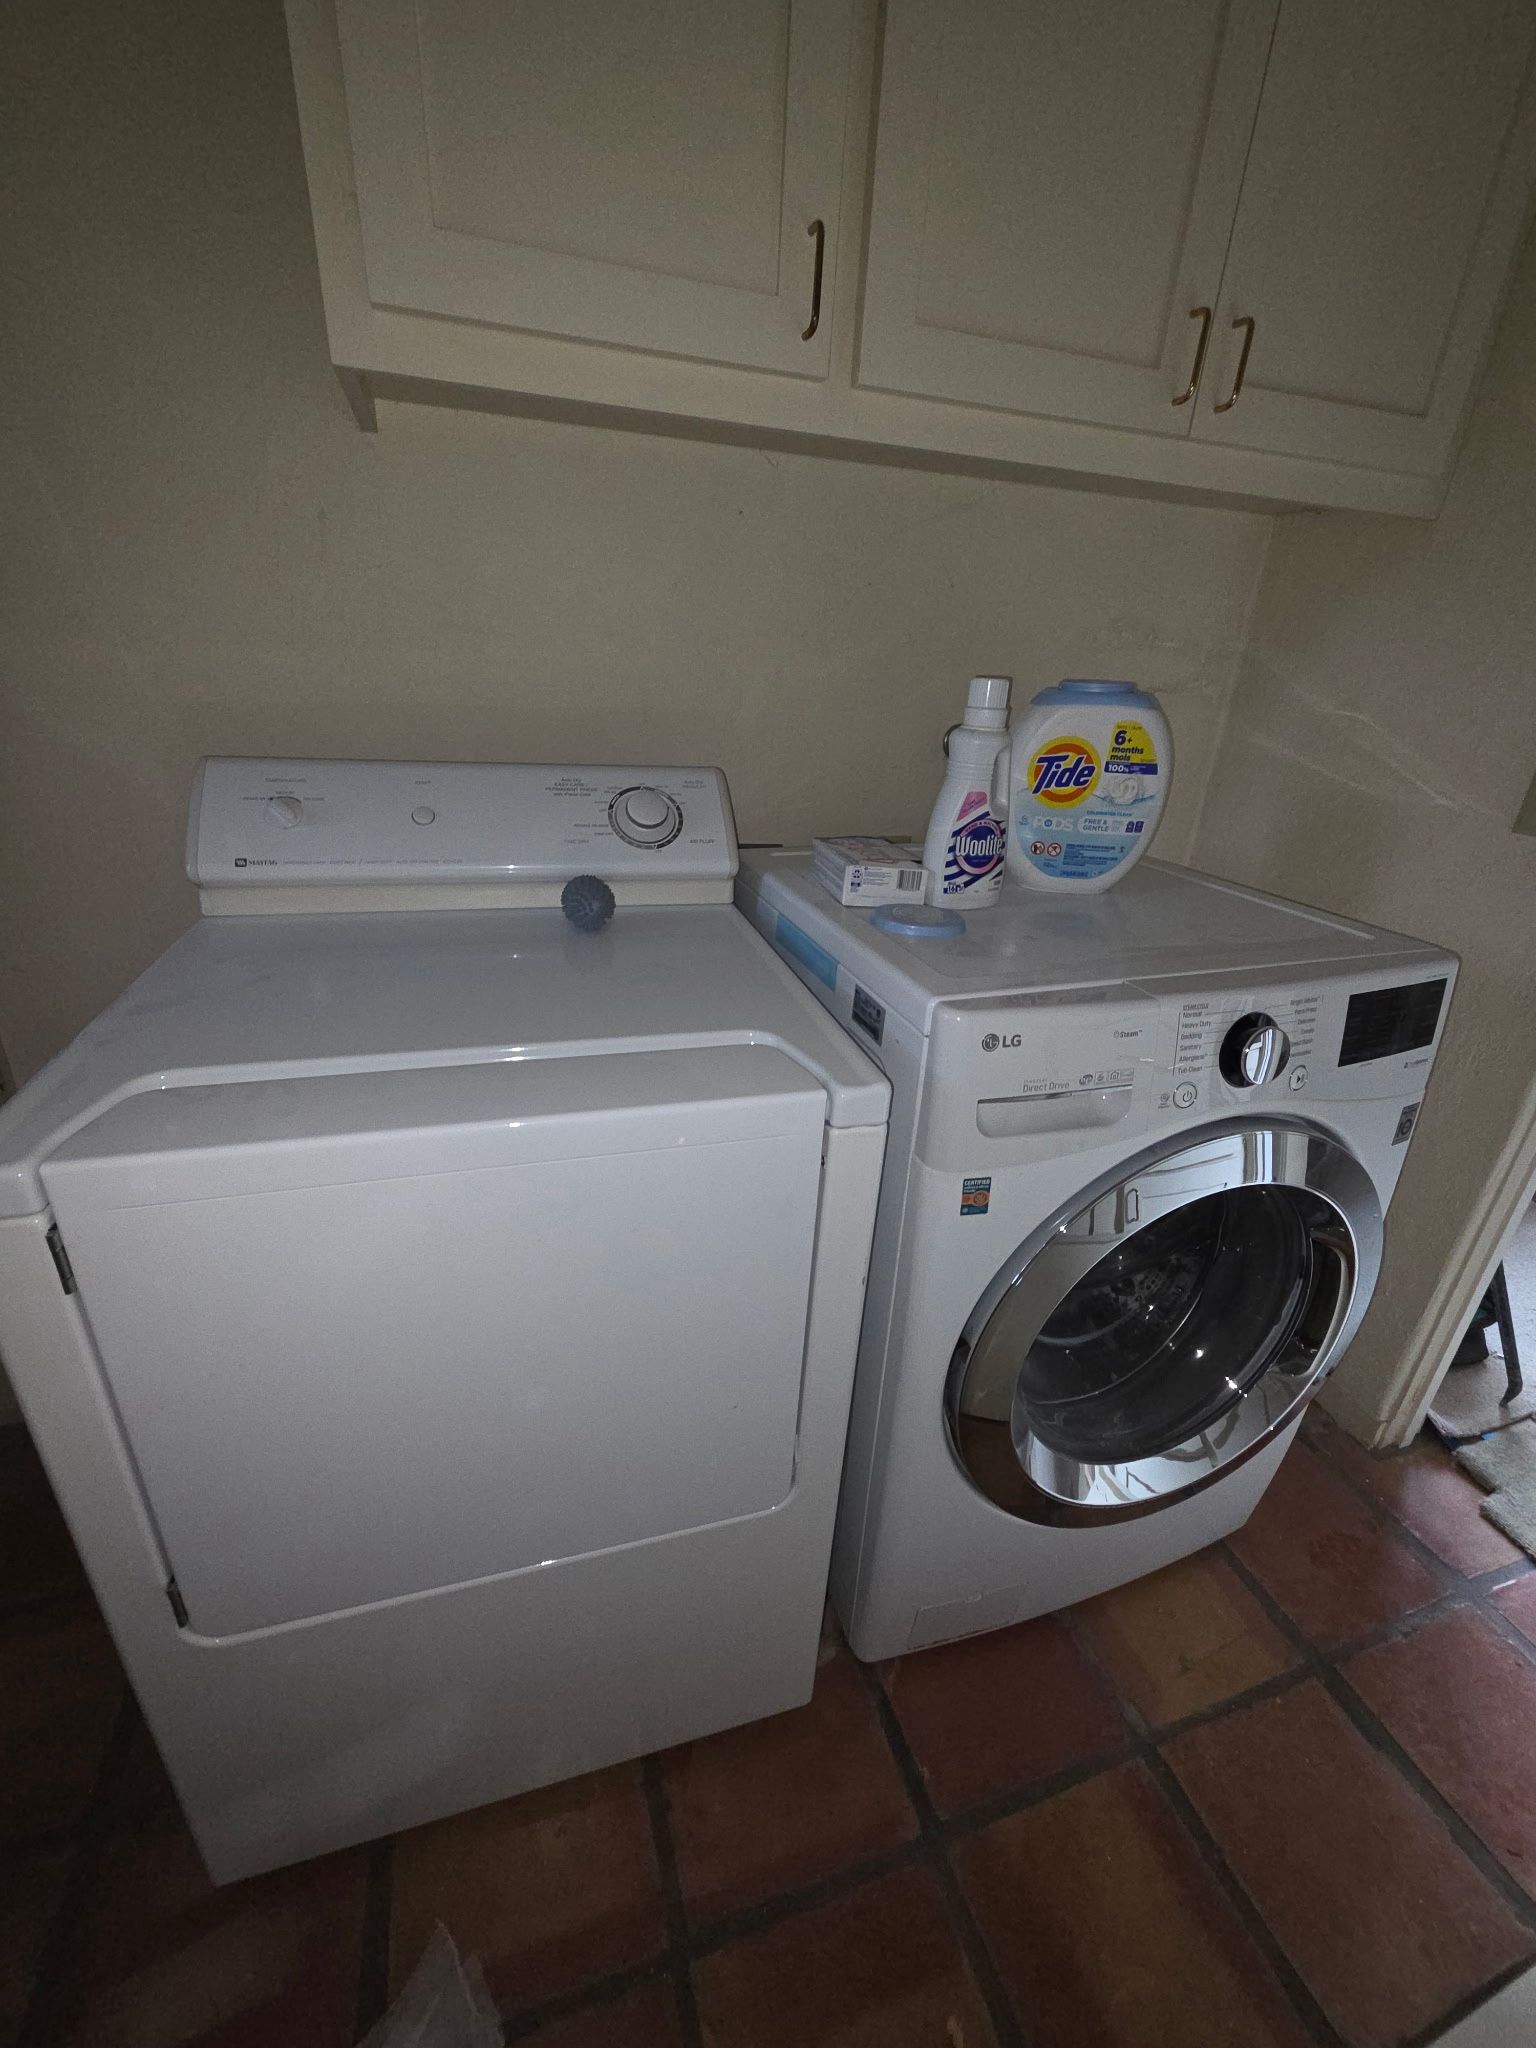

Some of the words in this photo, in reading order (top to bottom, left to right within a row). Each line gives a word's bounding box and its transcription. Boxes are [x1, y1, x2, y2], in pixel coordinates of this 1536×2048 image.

[1111, 745, 1144, 756] months
[1109, 752, 1131, 762] mois
[1031, 754, 1096, 795] Tide
[955, 834, 1002, 857] Woolite
[1182, 1010, 1202, 1019] Normal
[1199, 1020, 1212, 1029] Duty
[1002, 1034, 1022, 1048] LG
[1022, 1083, 1048, 1093] Direct
[1048, 1081, 1070, 1090] Drive
